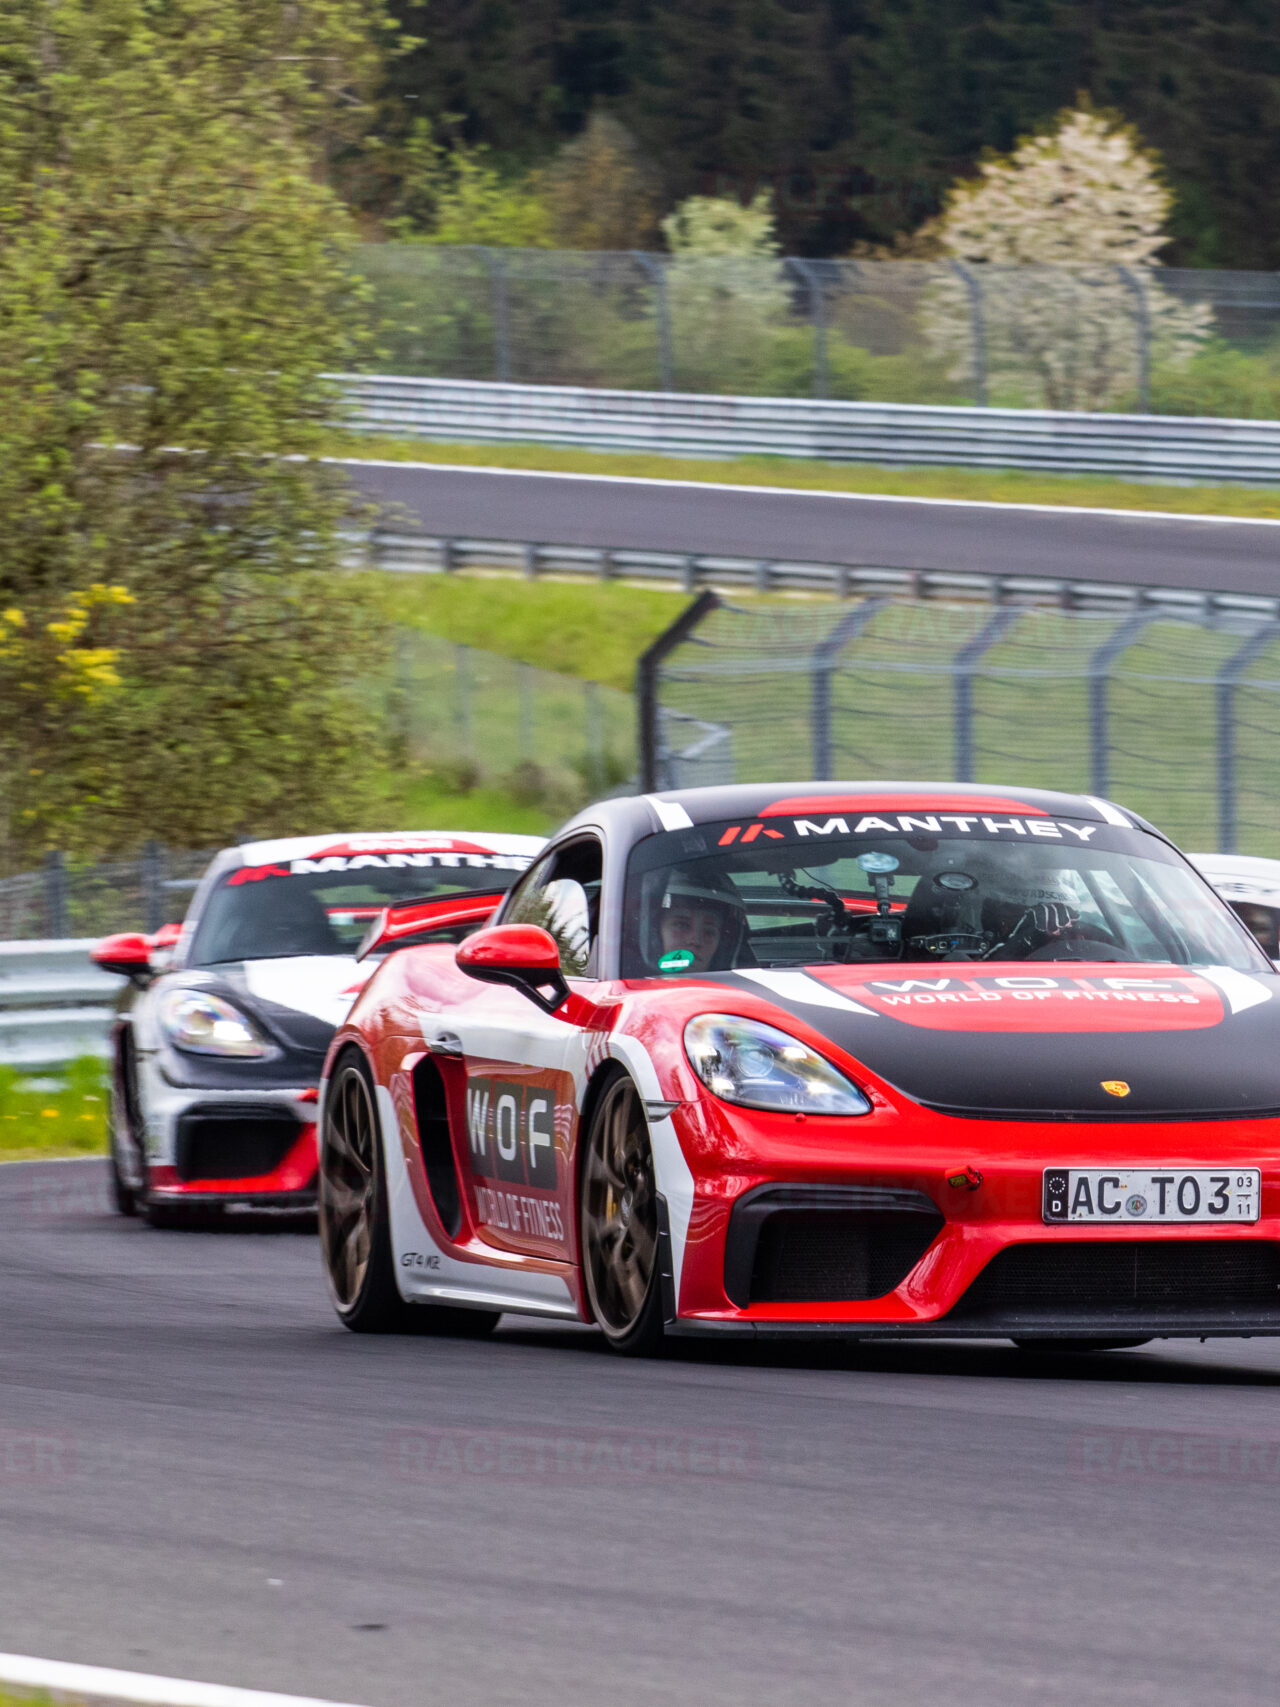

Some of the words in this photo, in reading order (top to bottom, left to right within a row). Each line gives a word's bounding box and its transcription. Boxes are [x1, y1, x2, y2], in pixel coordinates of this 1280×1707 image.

[793, 815, 1097, 841] MANTHEY
[291, 853, 533, 874] MANTHE
[880, 991, 1002, 1006] WORLD
[1011, 989, 1051, 1001] OF
[1063, 990, 1201, 1004] FITNESS
[1237, 1176, 1253, 1188] 03
[1052, 1200, 1062, 1212] D
[1071, 1176, 1122, 1215] AC
[474, 1184, 509, 1230] WORLD
[520, 1196, 564, 1240] FITNESS
[1237, 1202, 1251, 1215] 11
